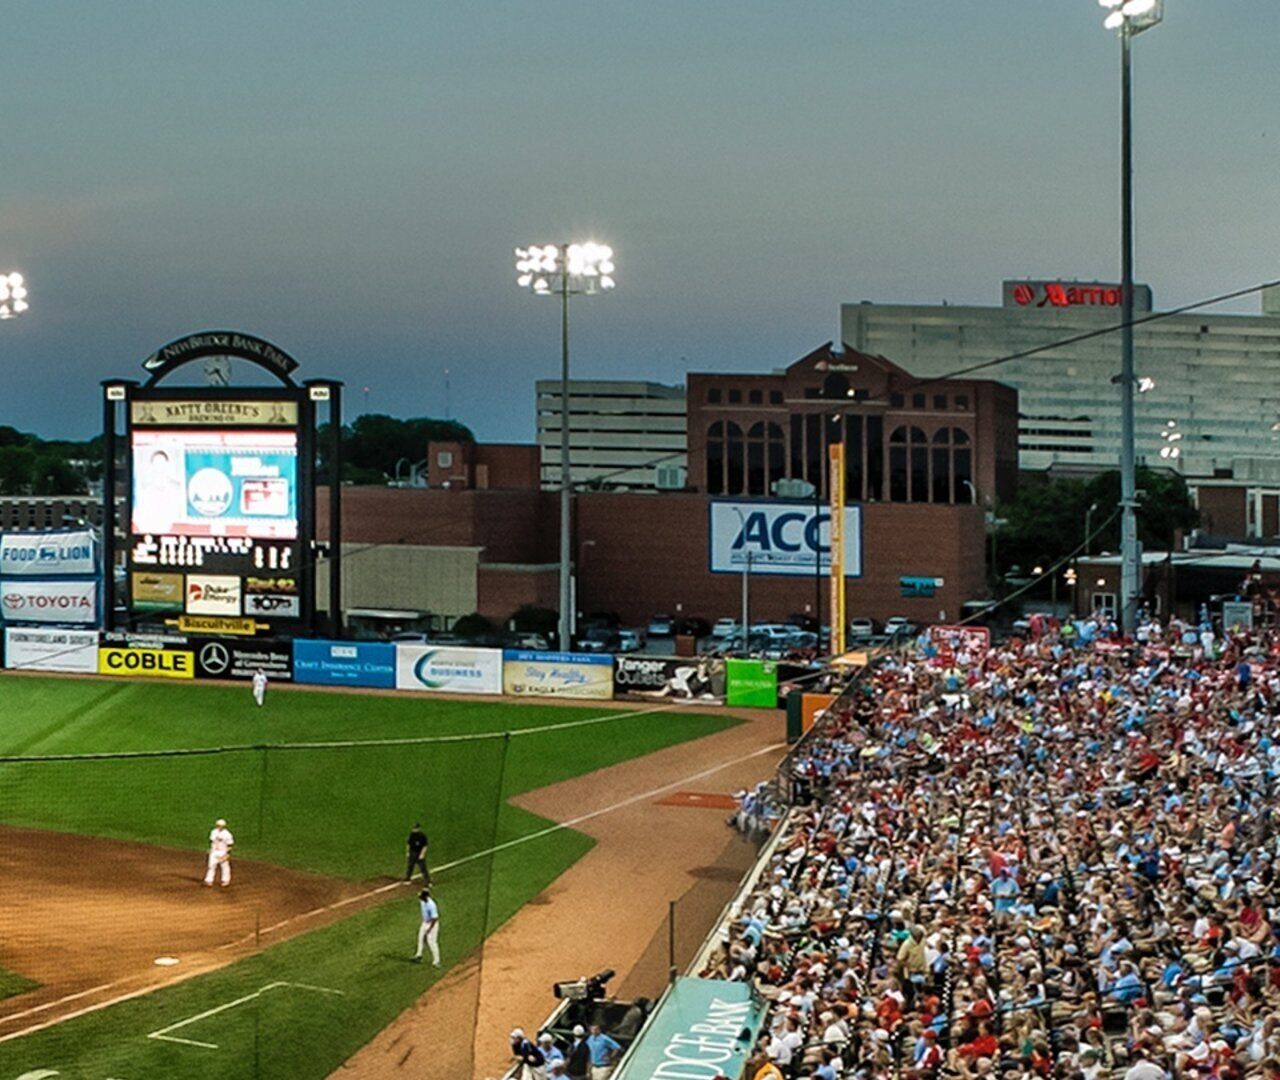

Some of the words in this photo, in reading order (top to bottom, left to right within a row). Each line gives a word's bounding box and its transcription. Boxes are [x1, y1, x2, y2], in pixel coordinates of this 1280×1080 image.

[1037, 283, 1124, 307] Marrio
[166, 403, 201, 417] NATTY
[731, 512, 831, 552] ACC
[3, 547, 36, 561] FOOD
[60, 546, 90, 560] LION
[27, 595, 91, 608] TOYOTA
[184, 617, 251, 630] Biscuitville
[107, 651, 187, 671] COBLE
[617, 657, 666, 673] Tanger
[430, 668, 483, 678] BUSINESS
[616, 670, 666, 685] Outlets
